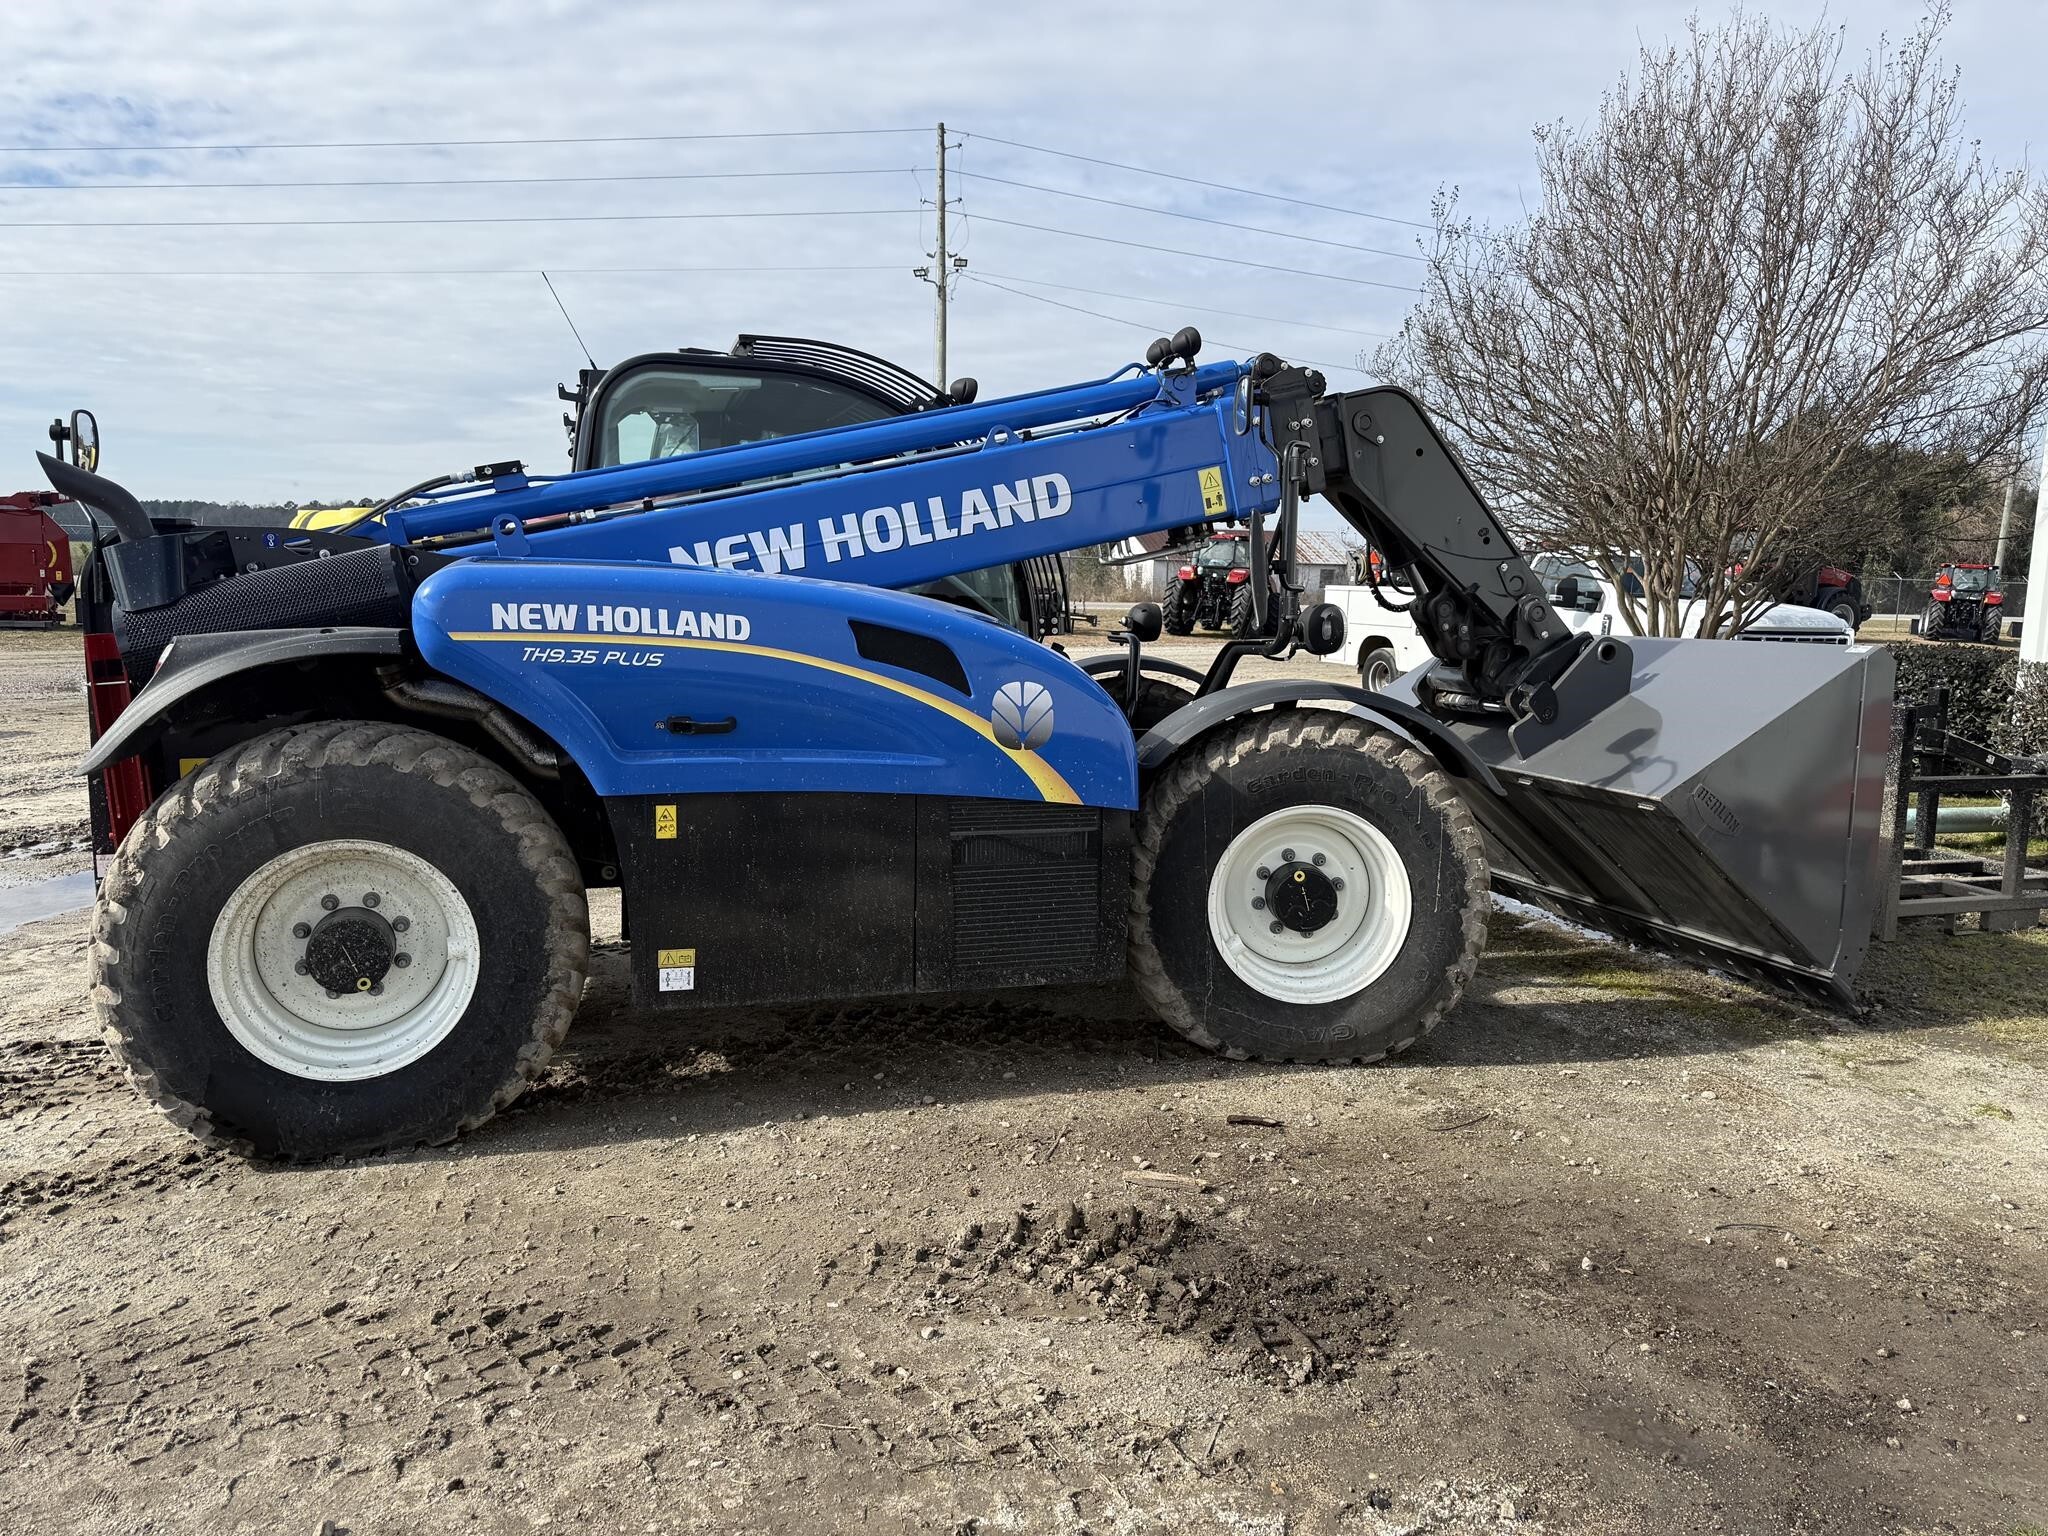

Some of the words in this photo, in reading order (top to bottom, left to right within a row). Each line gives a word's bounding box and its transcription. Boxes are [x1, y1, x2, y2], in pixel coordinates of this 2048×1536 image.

[818, 473, 1073, 563] HOLLAND
[491, 603, 578, 630] NEW
[587, 605, 751, 641] HOLLAND
[522, 648, 600, 664] TH9.35
[603, 651, 665, 667] PLUS
